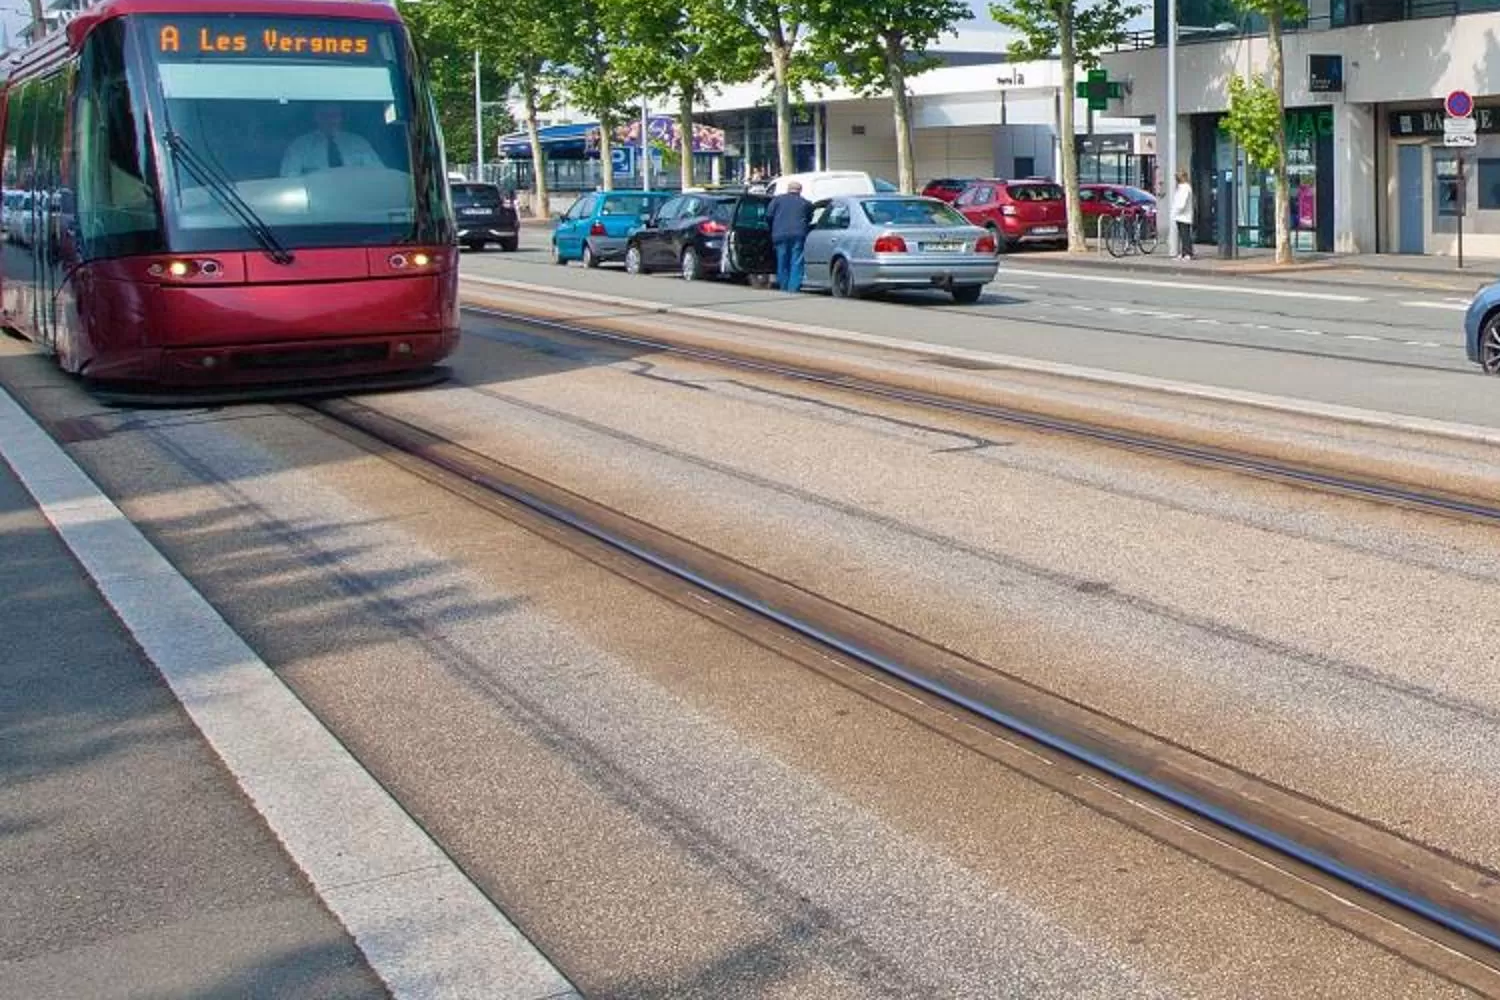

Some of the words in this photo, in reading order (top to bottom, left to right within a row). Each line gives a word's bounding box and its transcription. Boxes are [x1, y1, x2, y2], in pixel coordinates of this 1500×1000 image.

[160, 24, 180, 52] A
[200, 27, 248, 52] Les
[263, 28, 369, 54] Vergnes
